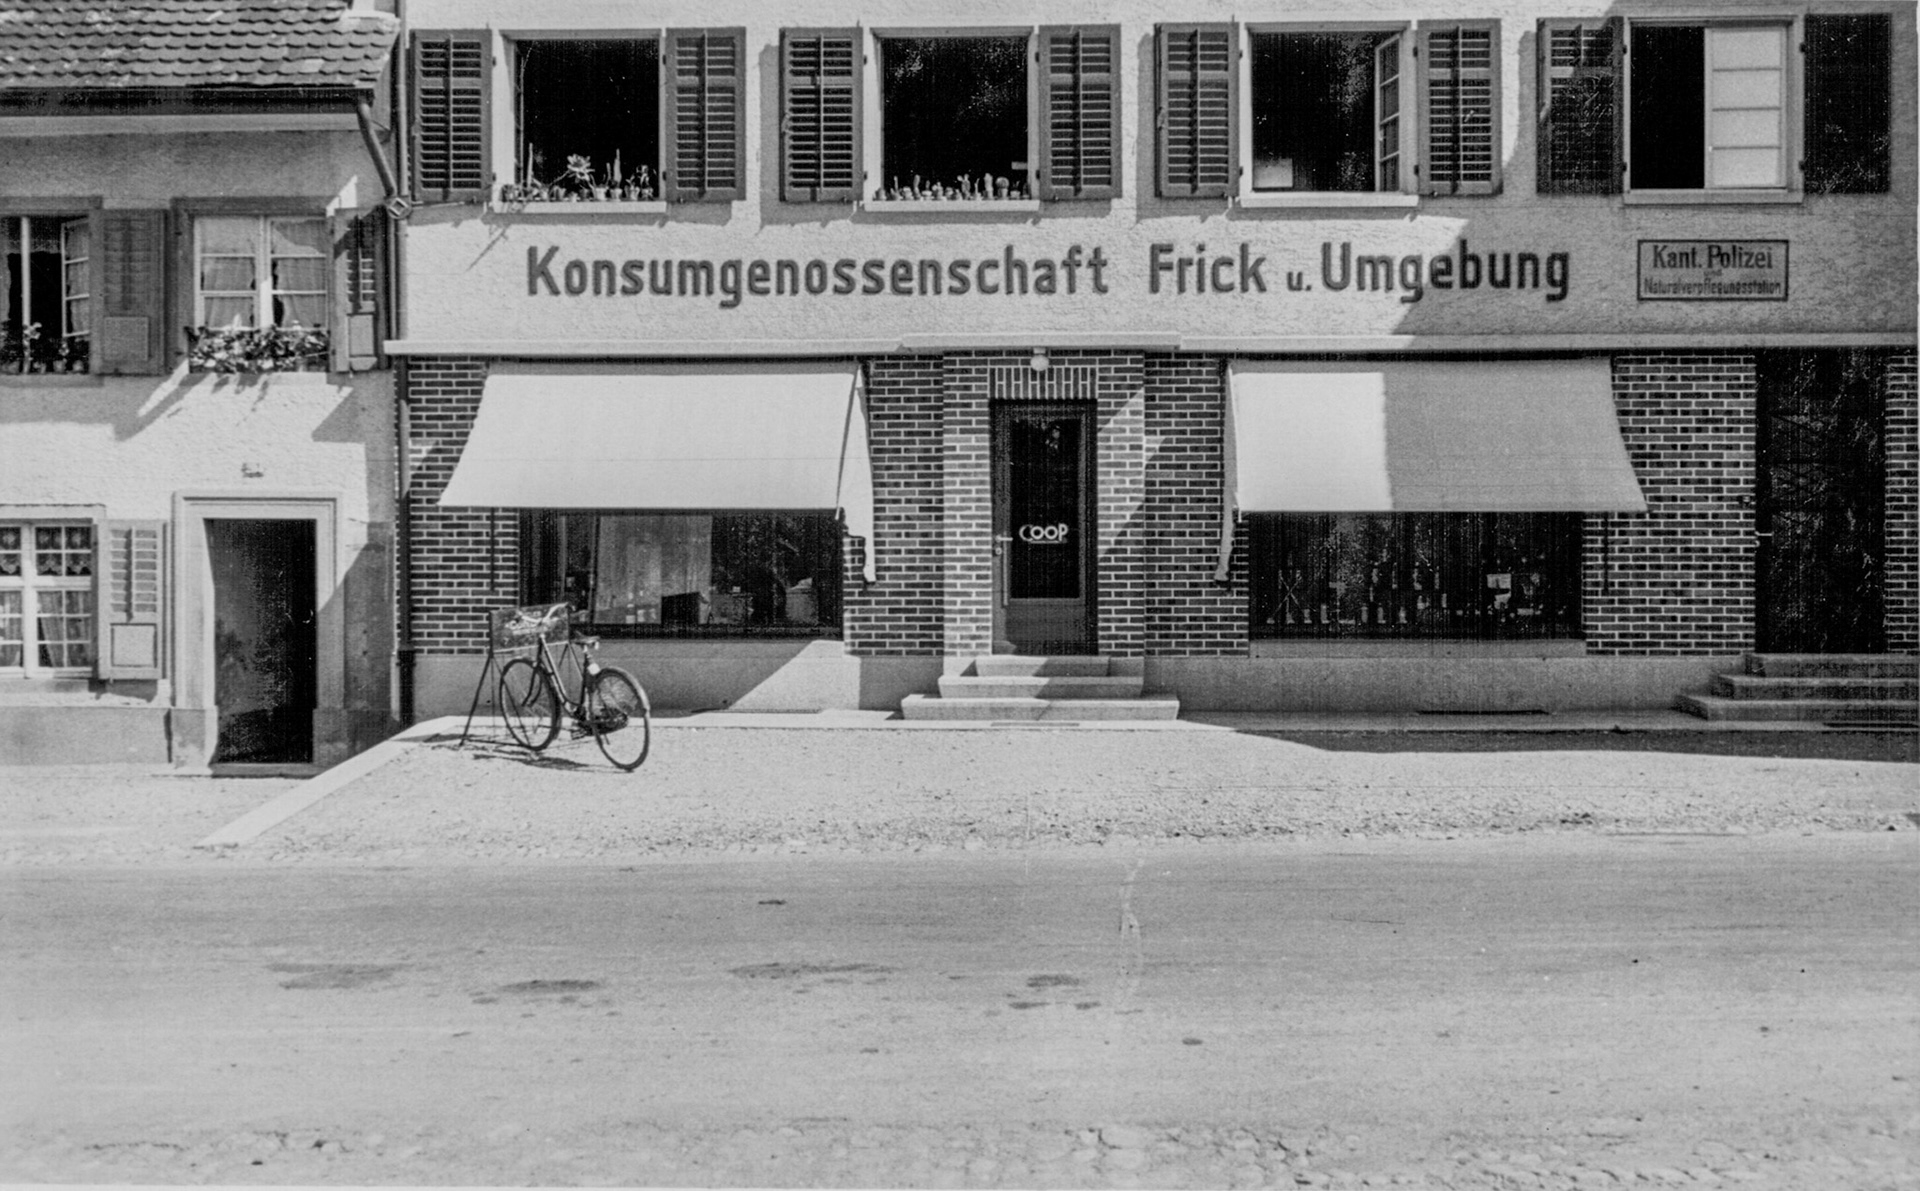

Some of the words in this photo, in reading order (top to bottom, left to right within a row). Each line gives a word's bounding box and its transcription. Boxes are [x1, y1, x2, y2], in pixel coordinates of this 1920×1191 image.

[1653, 245, 1702, 269] Kant.
[1707, 245, 1773, 269] Polizei
[526, 244, 1109, 309] Konsumgenossenschaft
[1149, 242, 1266, 294] Frick
[1286, 271, 1312, 291] u.
[1321, 239, 1570, 302] Umgebung
[1019, 523, 1068, 541] COOP
